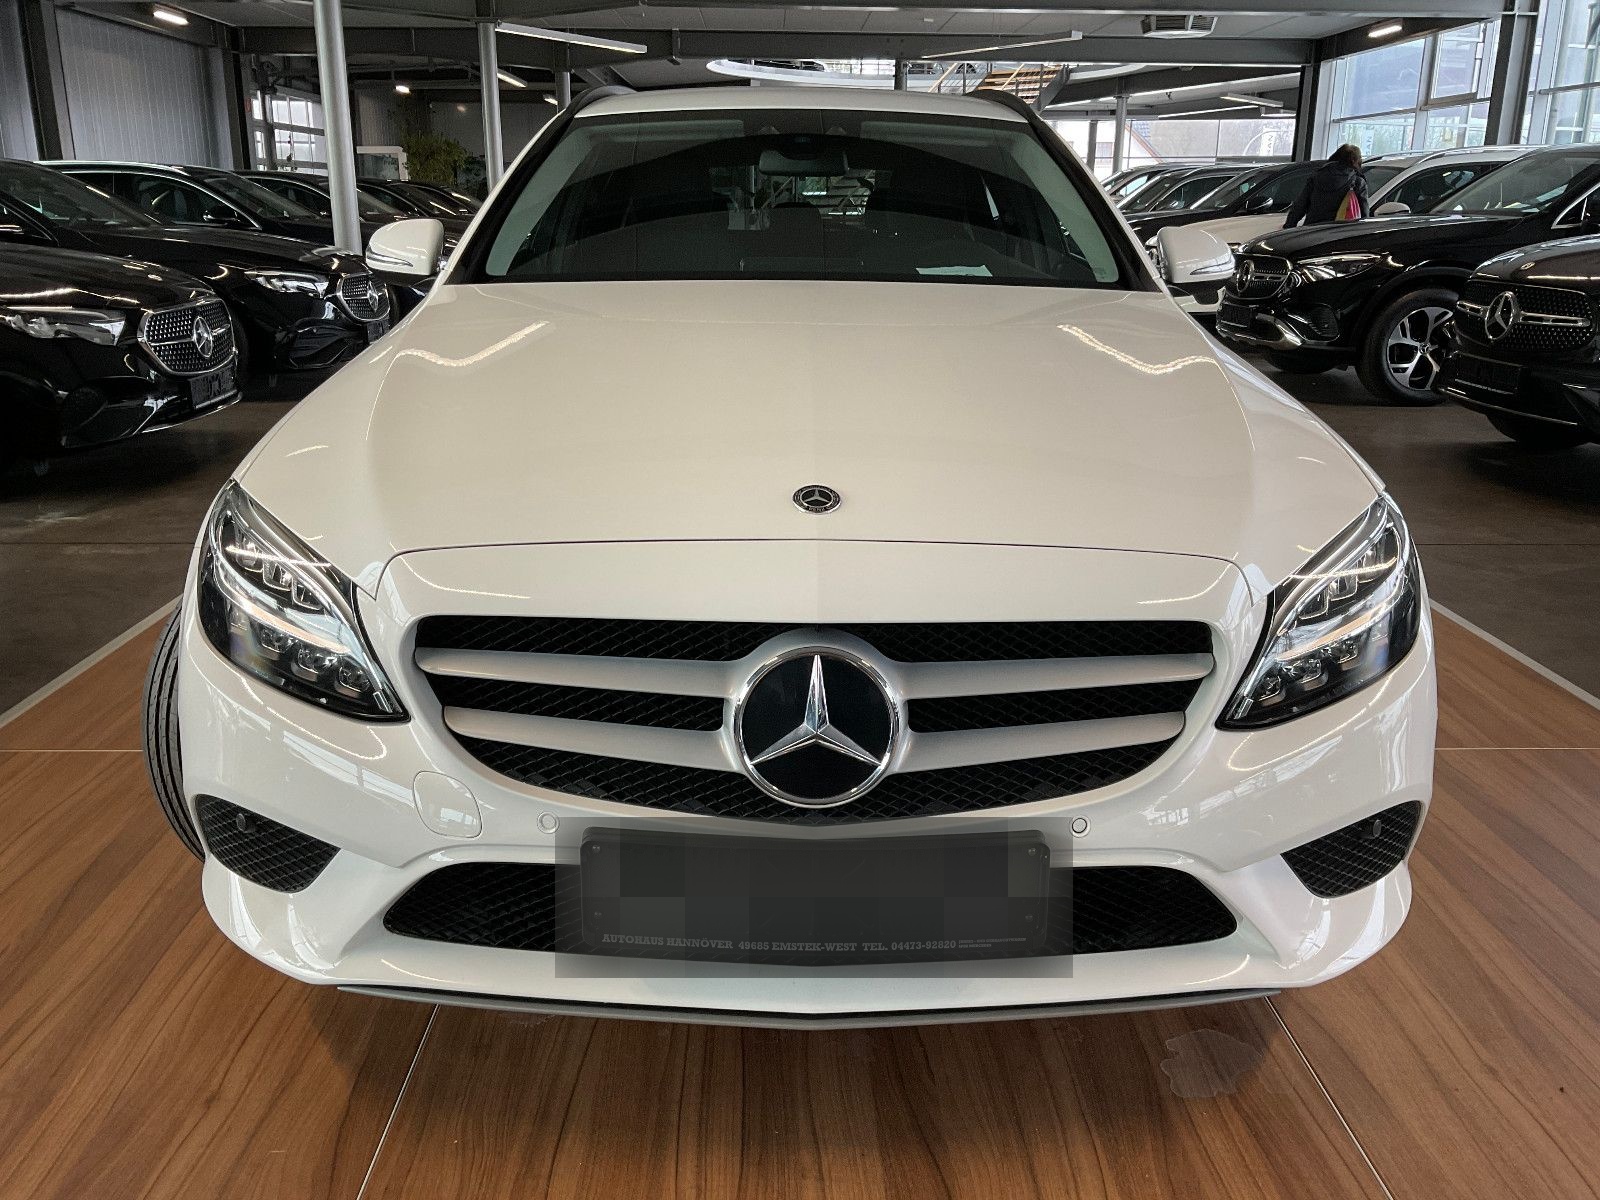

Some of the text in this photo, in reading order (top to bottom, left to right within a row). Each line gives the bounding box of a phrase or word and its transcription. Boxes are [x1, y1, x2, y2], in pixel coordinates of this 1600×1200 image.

[601, 933, 664, 946] AUTOHAUS
[666, 936, 733, 949] HANNÖVER
[738, 940, 770, 951] 49685
[771, 941, 858, 951] EMSTEK-WEST
[862, 942, 888, 951] TEL.
[891, 939, 956, 951] 04473-92820
